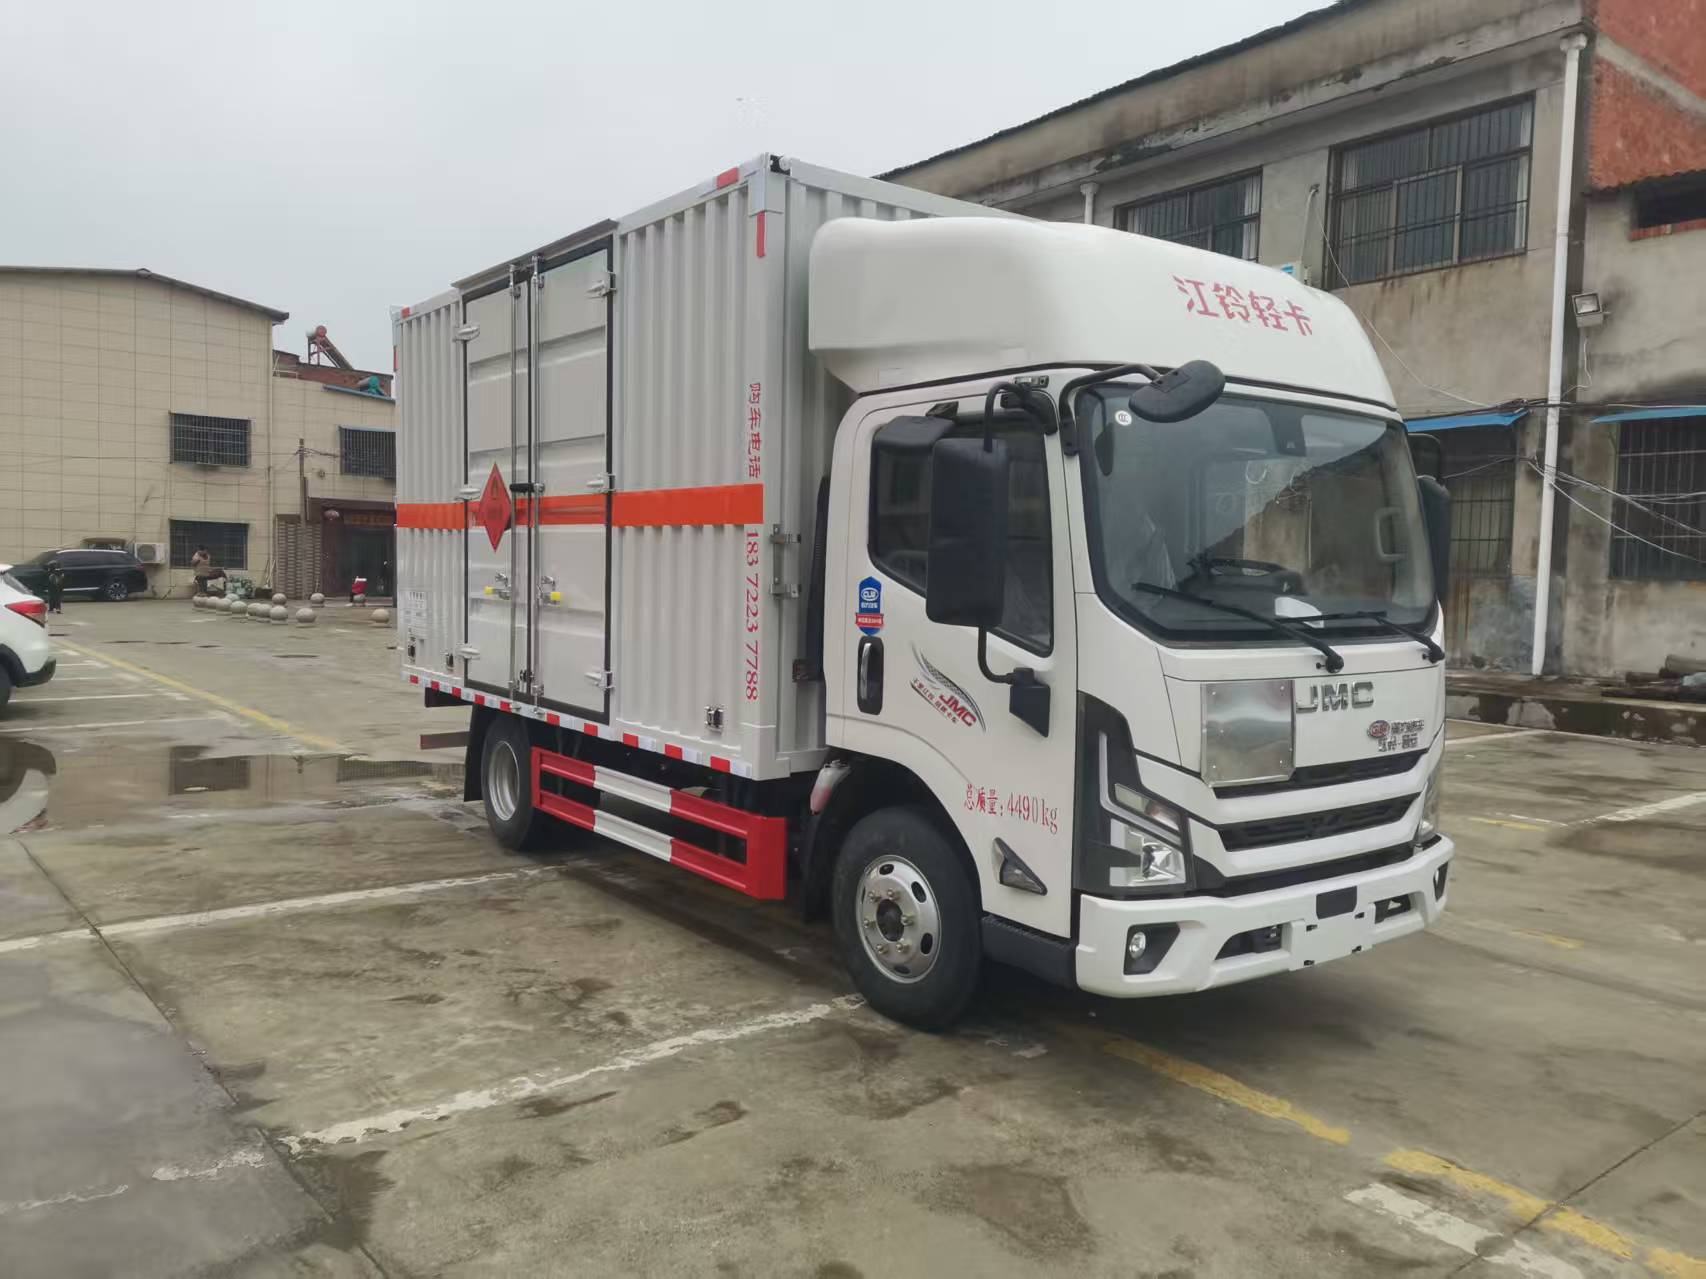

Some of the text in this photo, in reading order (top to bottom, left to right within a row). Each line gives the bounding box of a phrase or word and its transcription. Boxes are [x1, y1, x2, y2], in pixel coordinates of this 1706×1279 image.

[1172, 275, 1313, 336] 江铃轻卡
[748, 382, 762, 479] 购车电话
[746, 530, 759, 701] 183 7223 7788
[939, 693, 977, 727] JMC
[1295, 681, 1374, 713] JMC
